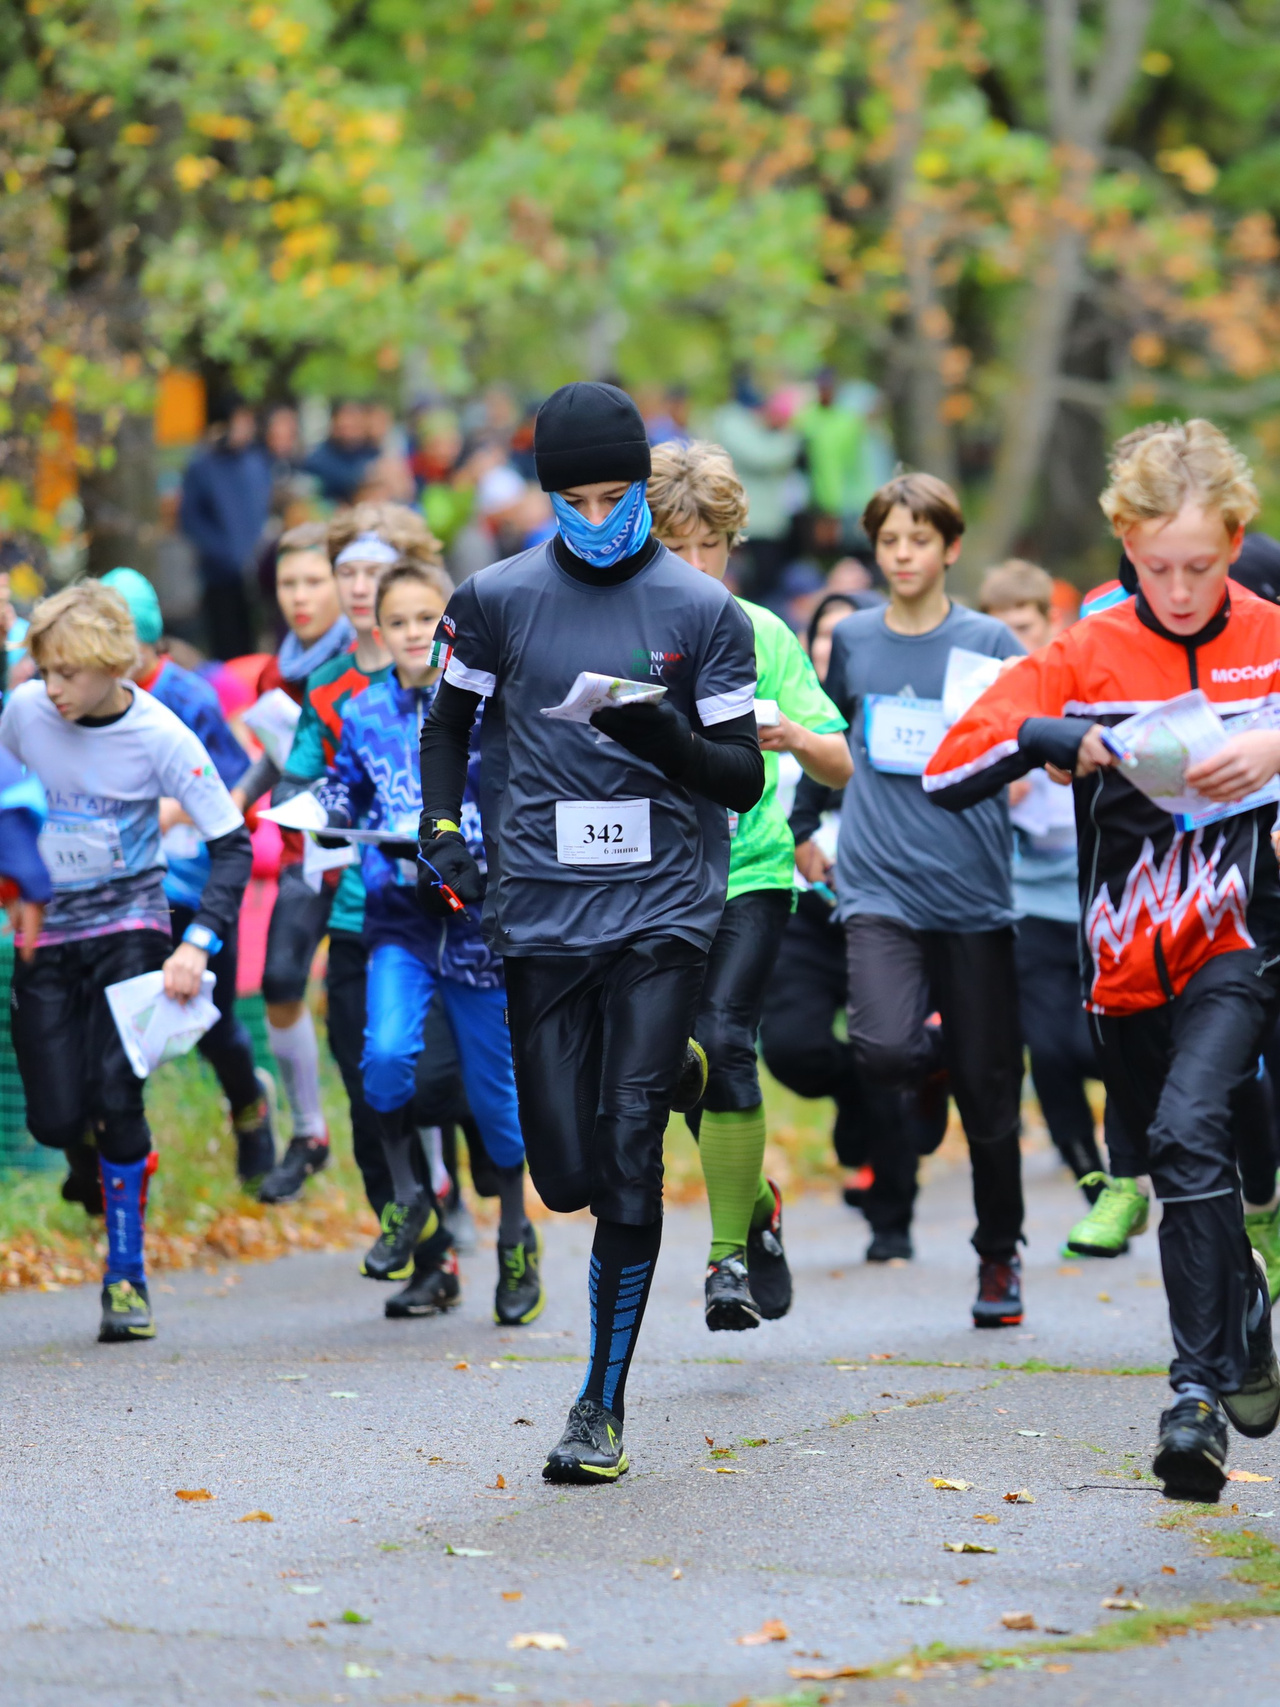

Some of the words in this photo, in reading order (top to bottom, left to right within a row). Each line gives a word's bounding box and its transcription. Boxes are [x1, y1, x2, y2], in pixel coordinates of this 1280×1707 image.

[632, 649, 683, 663] IRONMAN
[632, 662, 664, 676] ITALY
[891, 726, 926, 746] 327
[583, 824, 623, 844] 342
[603, 846, 609, 855] 6
[611, 846, 639, 855] линия
[56, 851, 88, 866] 335
